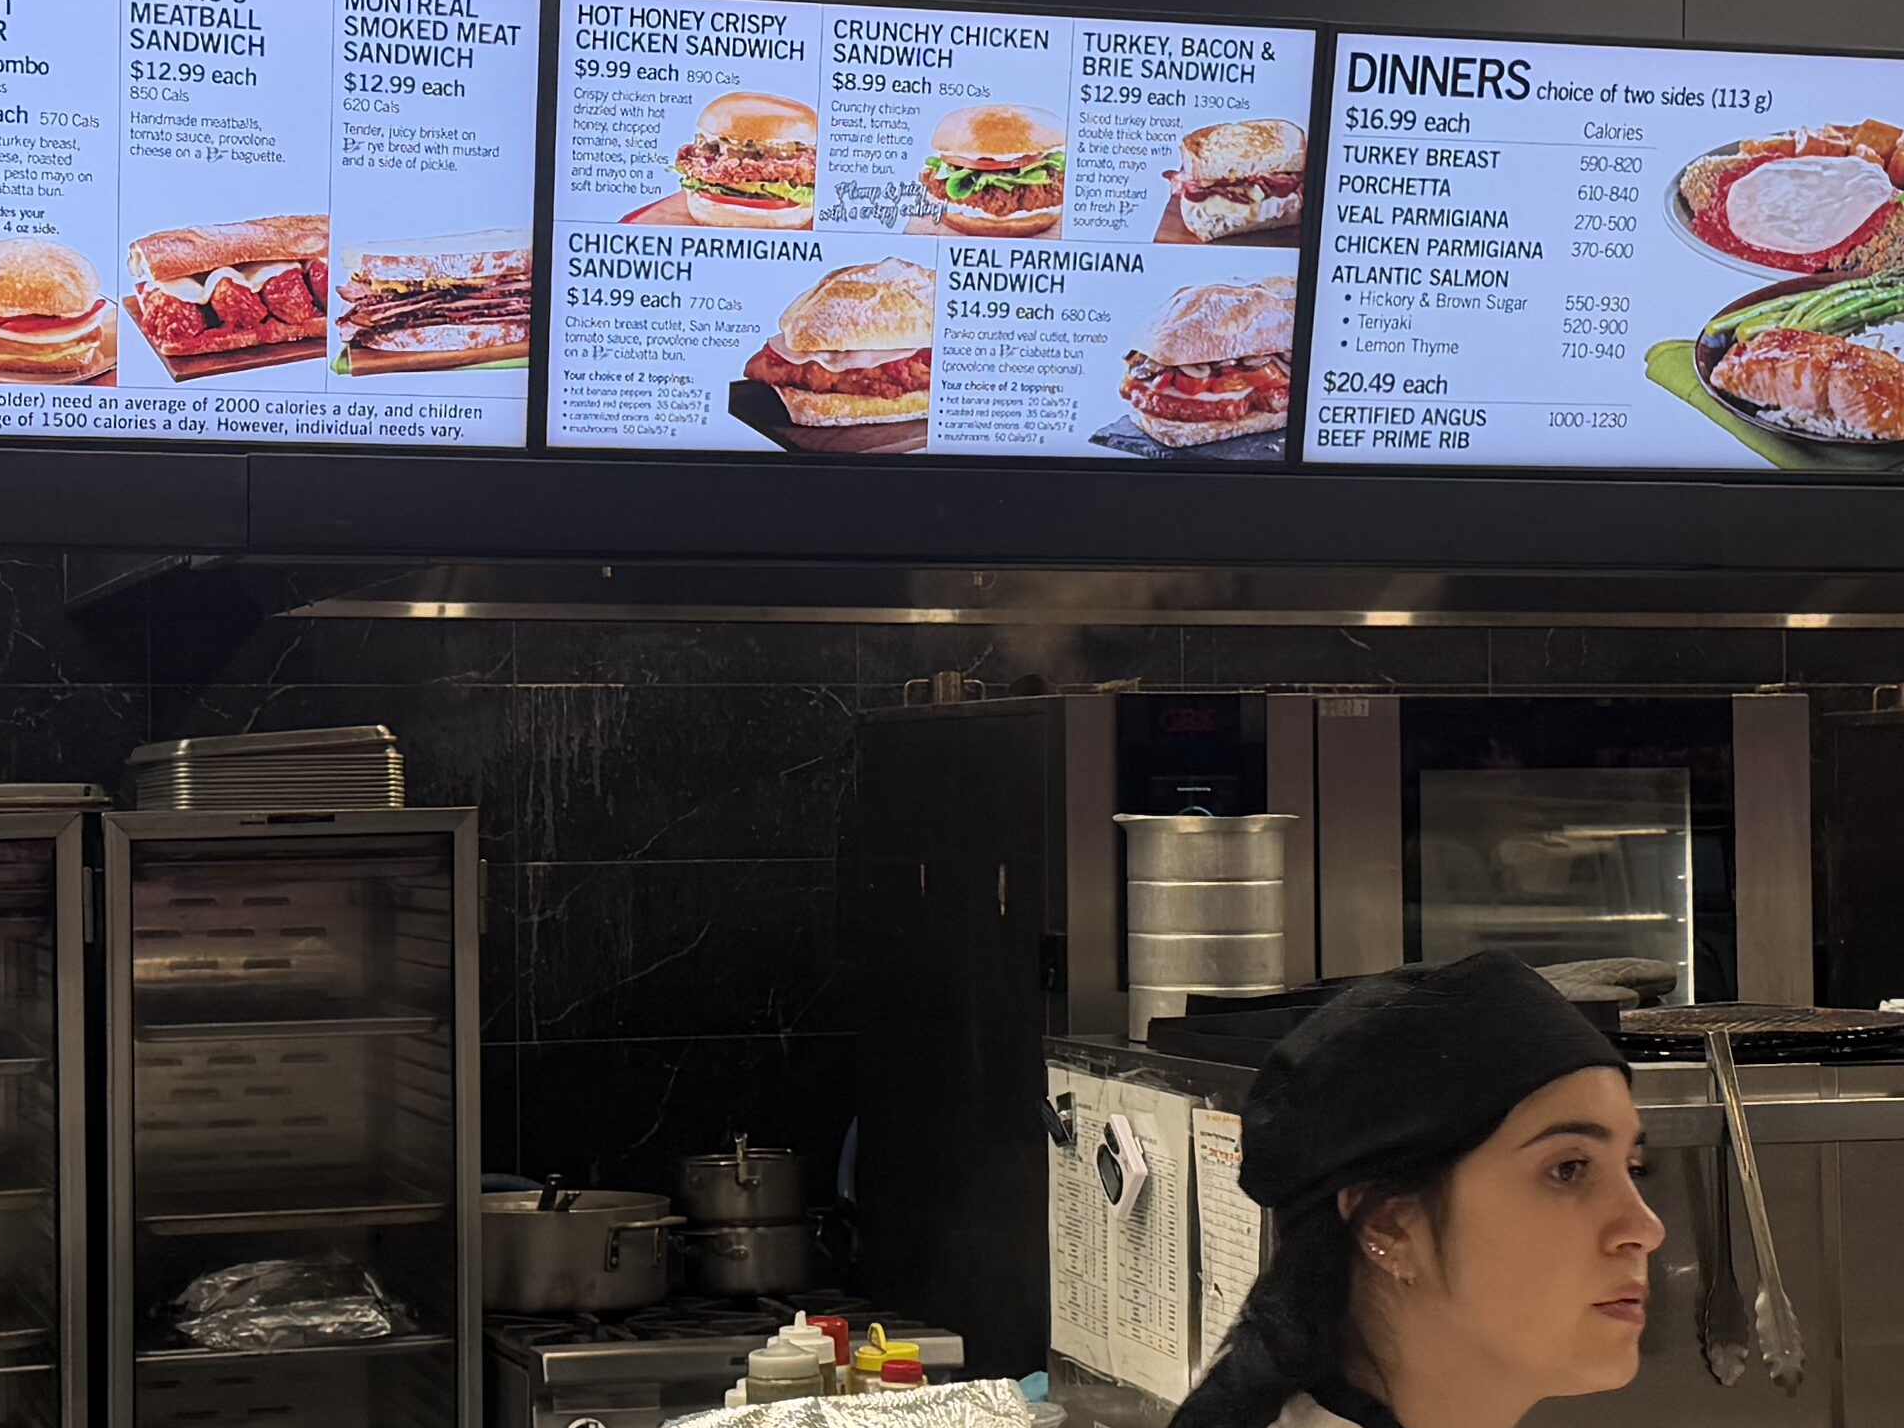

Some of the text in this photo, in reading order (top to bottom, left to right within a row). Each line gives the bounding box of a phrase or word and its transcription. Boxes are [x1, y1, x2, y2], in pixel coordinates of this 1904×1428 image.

[131, 2, 261, 30] MEATBALL
[578, 4, 787, 35] HOT HONEY CRISPY
[130, 28, 264, 56] SANDWICH
[344, 16, 521, 45] SMOKED MEAT
[834, 19, 1048, 49] CRUNCHY CHICKEN
[344, 41, 473, 68] SANDWICH
[576, 29, 804, 61] CHICKEN SANDWICH
[833, 43, 952, 68] SANDWICH
[1083, 33, 1275, 61] TURKEY, BACON &
[131, 60, 256, 86] $12.99 each
[575, 58, 678, 81] $9.99 each
[1083, 57, 1255, 83] BRIE SANDWICH
[1348, 52, 1772, 113] DINNERS choice of two sides (113 g)
[345, 72, 464, 97] $12.99 each
[1346, 107, 1643, 140] $16.99 each Calories
[1343, 145, 1642, 173] TURKEY BREAST 590-820
[1339, 175, 1638, 202] PORCHETTA 610-840
[1338, 205, 1636, 232] VEAL PARMIGIANA 270-500
[569, 233, 822, 261] CHICKEN PARMIGIANA
[950, 247, 1143, 273] VEAL PARMIGIANA
[1335, 235, 1633, 259] CHICKEN PARMIGIANA 370-600
[569, 258, 691, 281] SANDWICH
[949, 272, 1064, 293] SANDWICH
[1332, 265, 1508, 287] ATLANTIC SALMON
[1360, 291, 1629, 313] Hickory & Brown Sugar 550-930
[1358, 314, 1411, 333] Teriyaki
[1323, 371, 1447, 395] $20.49 each
[1319, 406, 1486, 426] CERTIFIED ANGUS
[1318, 429, 1469, 448] BEEF PRIME RIB
